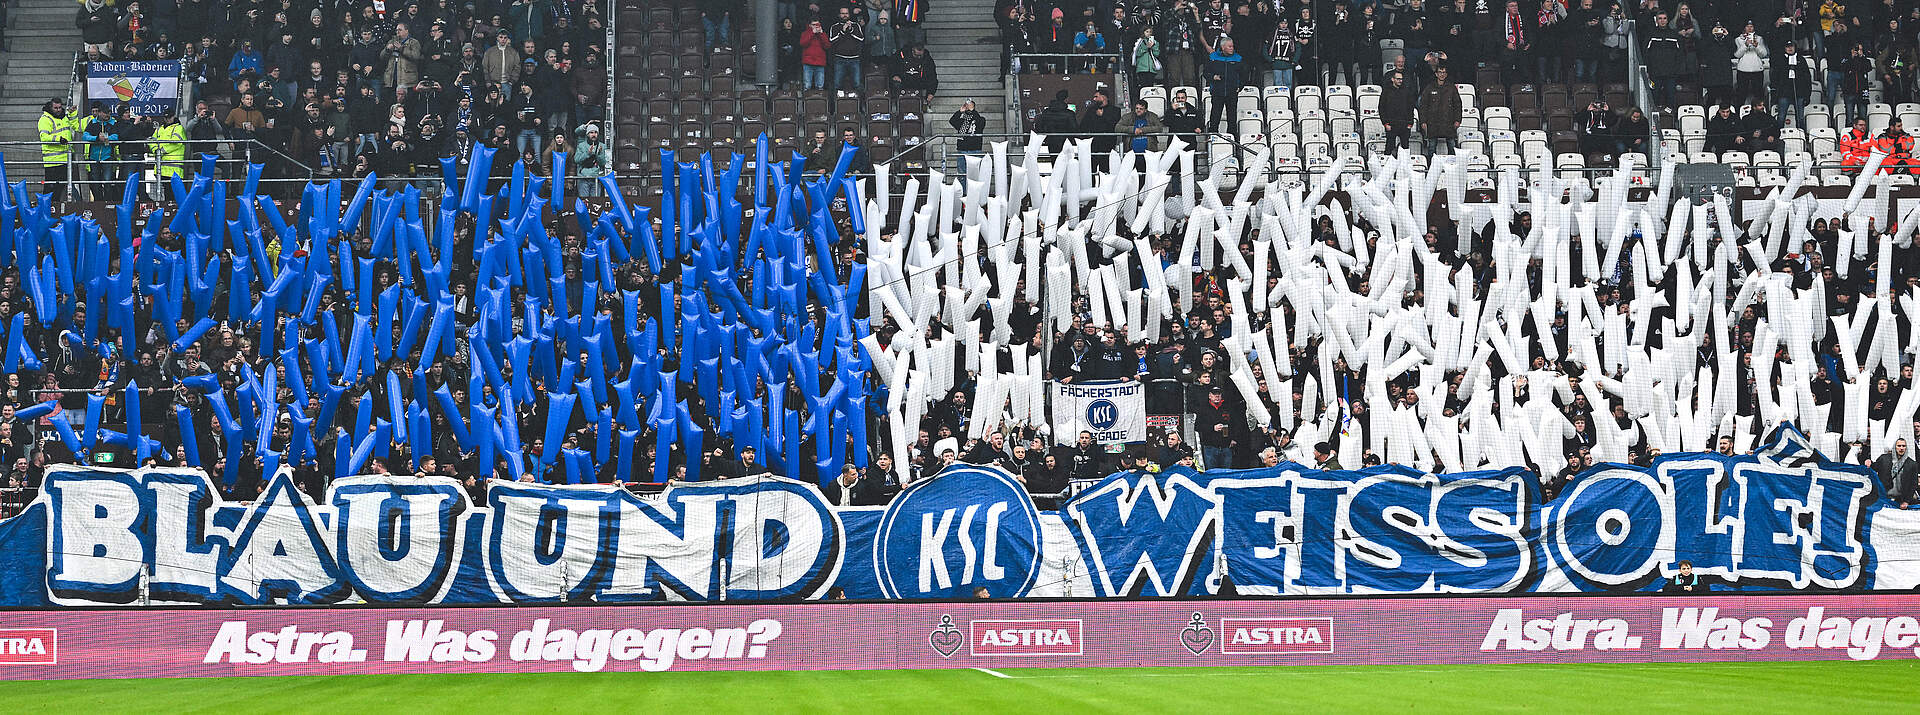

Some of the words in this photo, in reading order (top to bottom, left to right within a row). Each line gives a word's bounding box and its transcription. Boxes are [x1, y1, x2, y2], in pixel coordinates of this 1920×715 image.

[1276, 40, 1290, 56] 17
[92, 61, 173, 72] Baden-Badener
[1060, 384, 1141, 398] FÄCHERSTADT
[1093, 405, 1112, 424] KSC
[50, 472, 455, 602] BLAU
[490, 480, 838, 602] UND
[1069, 474, 1528, 598] WEISS
[919, 502, 1008, 593] KSC
[980, 628, 1073, 647] ASTRA
[1231, 626, 1324, 645] ASTRA
[1480, 608, 1642, 652] Astra.
[1659, 606, 1774, 650] Was
[1784, 606, 1920, 662] dage
[204, 620, 367, 664] Astra.
[383, 619, 498, 663] Was
[509, 618, 783, 673] dagegen?
